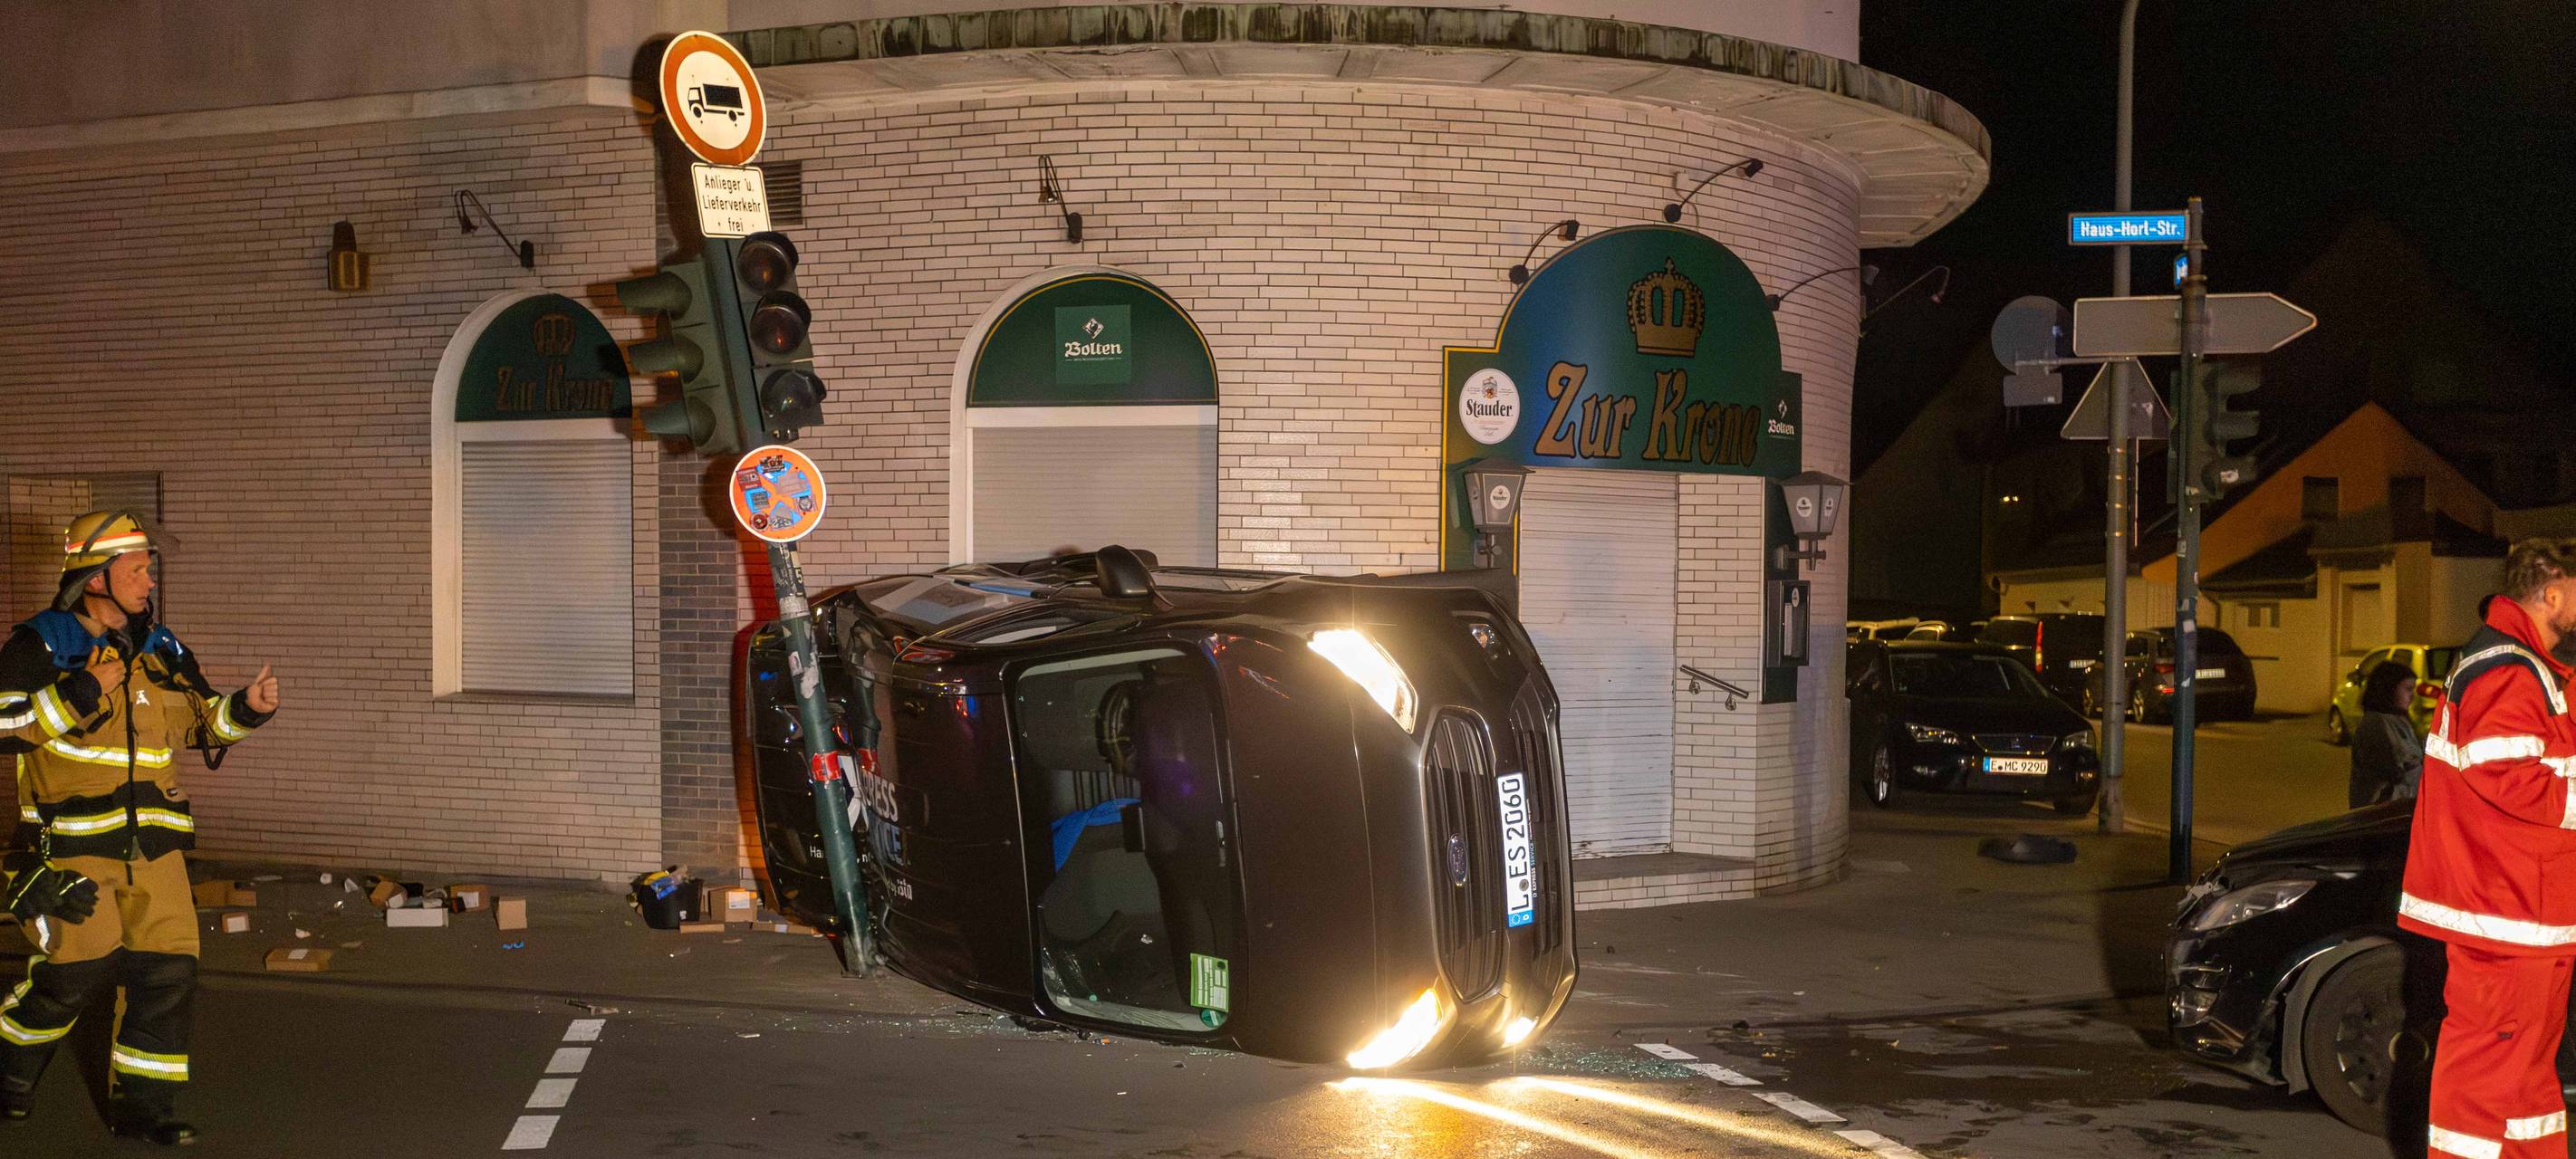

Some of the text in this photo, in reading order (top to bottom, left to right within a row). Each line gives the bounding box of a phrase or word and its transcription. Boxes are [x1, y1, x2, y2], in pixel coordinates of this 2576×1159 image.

[705, 174, 740, 194] Anlieger
[702, 196, 762, 213] Lieferverkehr
[728, 217, 744, 232] frei
[1064, 340, 1123, 357] Bolten
[1466, 398, 1513, 418] Stauder
[1533, 360, 1762, 467] Zur Krone
[1767, 418, 1795, 436] Bolten
[2004, 760, 2018, 771] MC
[2021, 761, 2047, 772] 9290
[1501, 778, 1530, 911] L ES 2060
